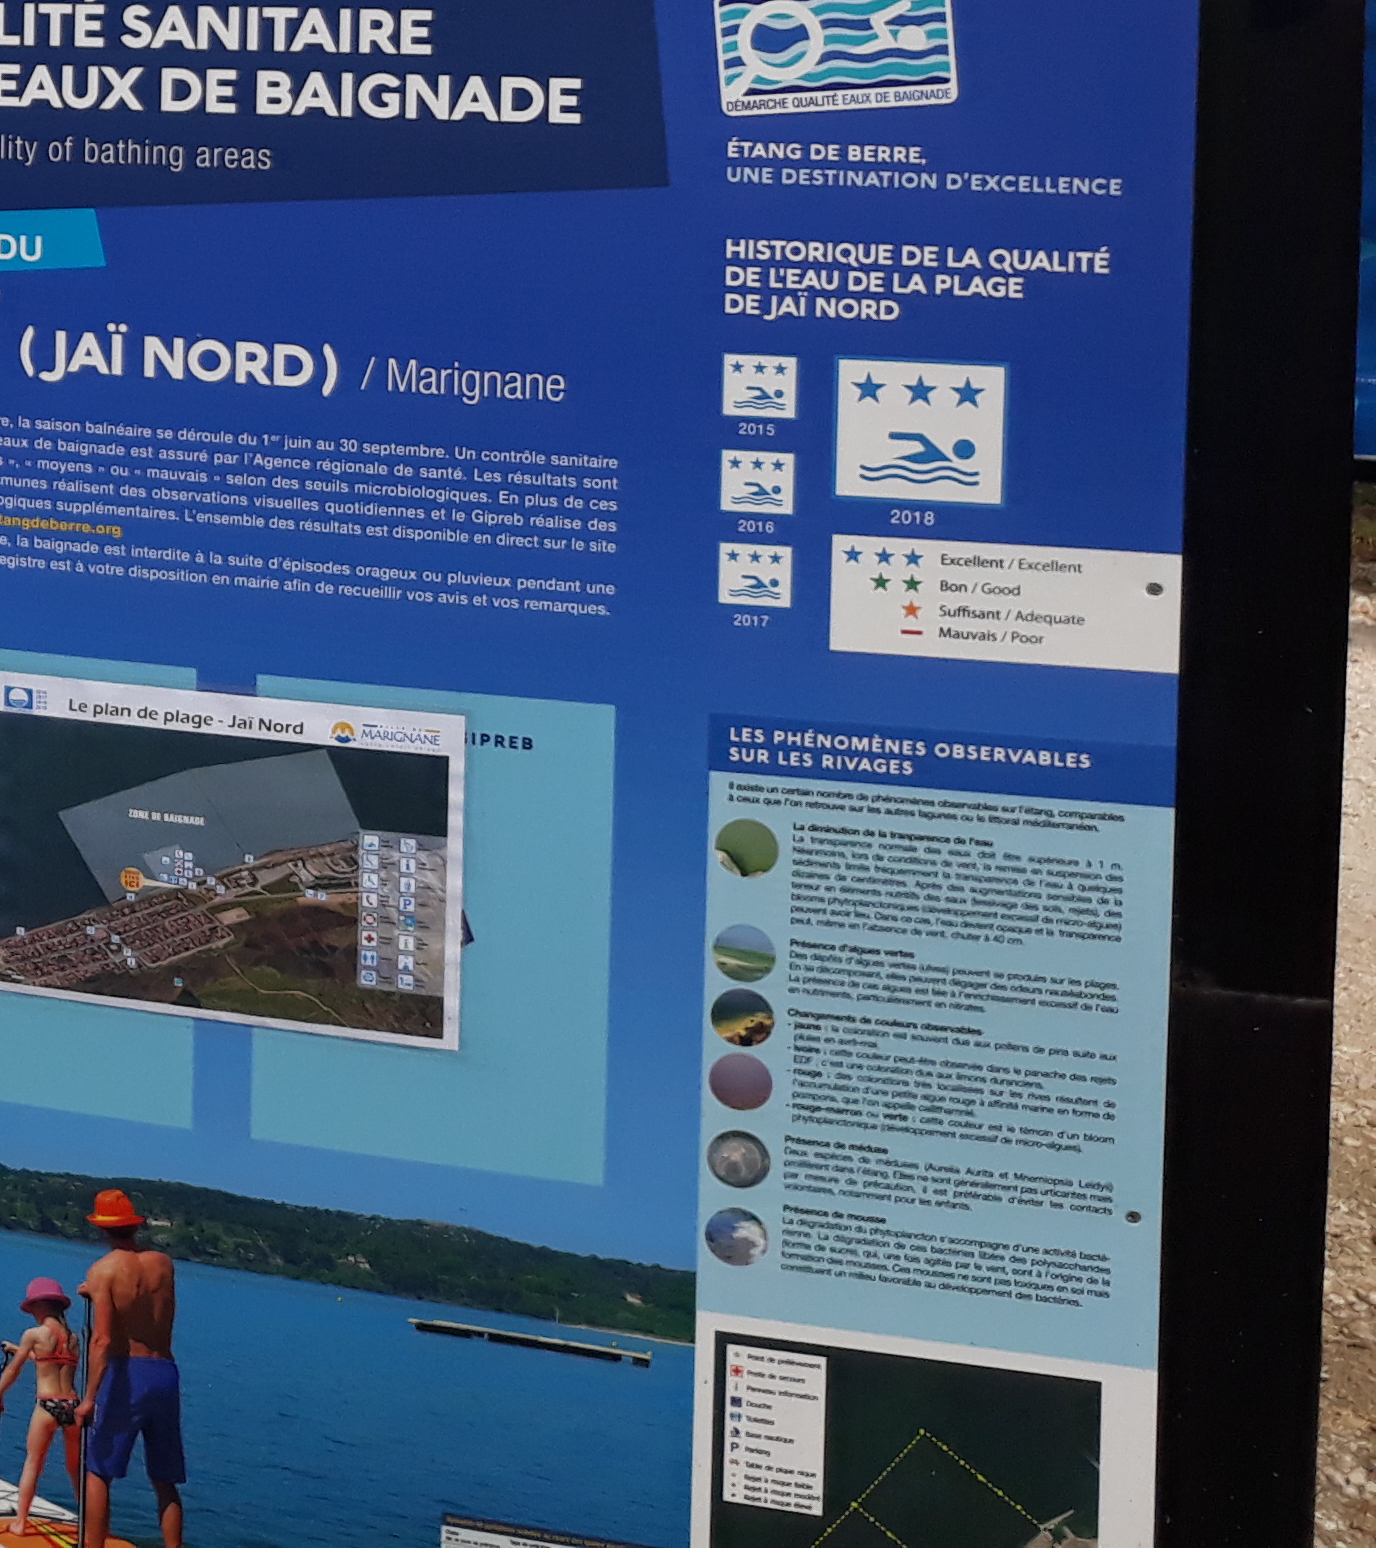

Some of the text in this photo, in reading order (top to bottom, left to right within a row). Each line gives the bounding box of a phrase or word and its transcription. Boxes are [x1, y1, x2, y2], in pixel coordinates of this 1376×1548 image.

[121, 5, 432, 54] SANITAIRE
[161, 68, 237, 113] DE
[256, 71, 581, 123] BAIGNADE
[49, 136, 73, 161] of
[85, 138, 183, 172] bathing
[196, 147, 271, 169] areas
[728, 137, 926, 164] ÉTANG DE BERRE,
[727, 167, 1122, 195] UNE DESTINATION D'EXCELLENCE
[726, 239, 1110, 273] HISTORIQUE DE LA QUALITÉ
[726, 266, 1023, 298] DE L'EAU DE LA PLAGE
[725, 292, 899, 320] DE JAÏ NORD
[144, 336, 337, 396] NORD)
[361, 357, 375, 389] /
[388, 358, 565, 404] Marignane
[739, 423, 774, 436] 2015
[738, 520, 774, 533] 2016
[891, 510, 934, 525] 2018
[734, 614, 769, 626] 2017
[69, 699, 87, 713] Le
[93, 703, 131, 717] plan
[137, 706, 158, 720] de
[164, 710, 213, 728] plage
[228, 715, 252, 729] Jaï
[259, 718, 303, 734] Nord
[729, 747, 913, 775] SUR LES RIVAGES
[730, 727, 1090, 768] LES PHÉNOMÈNES OBSERVABLES
